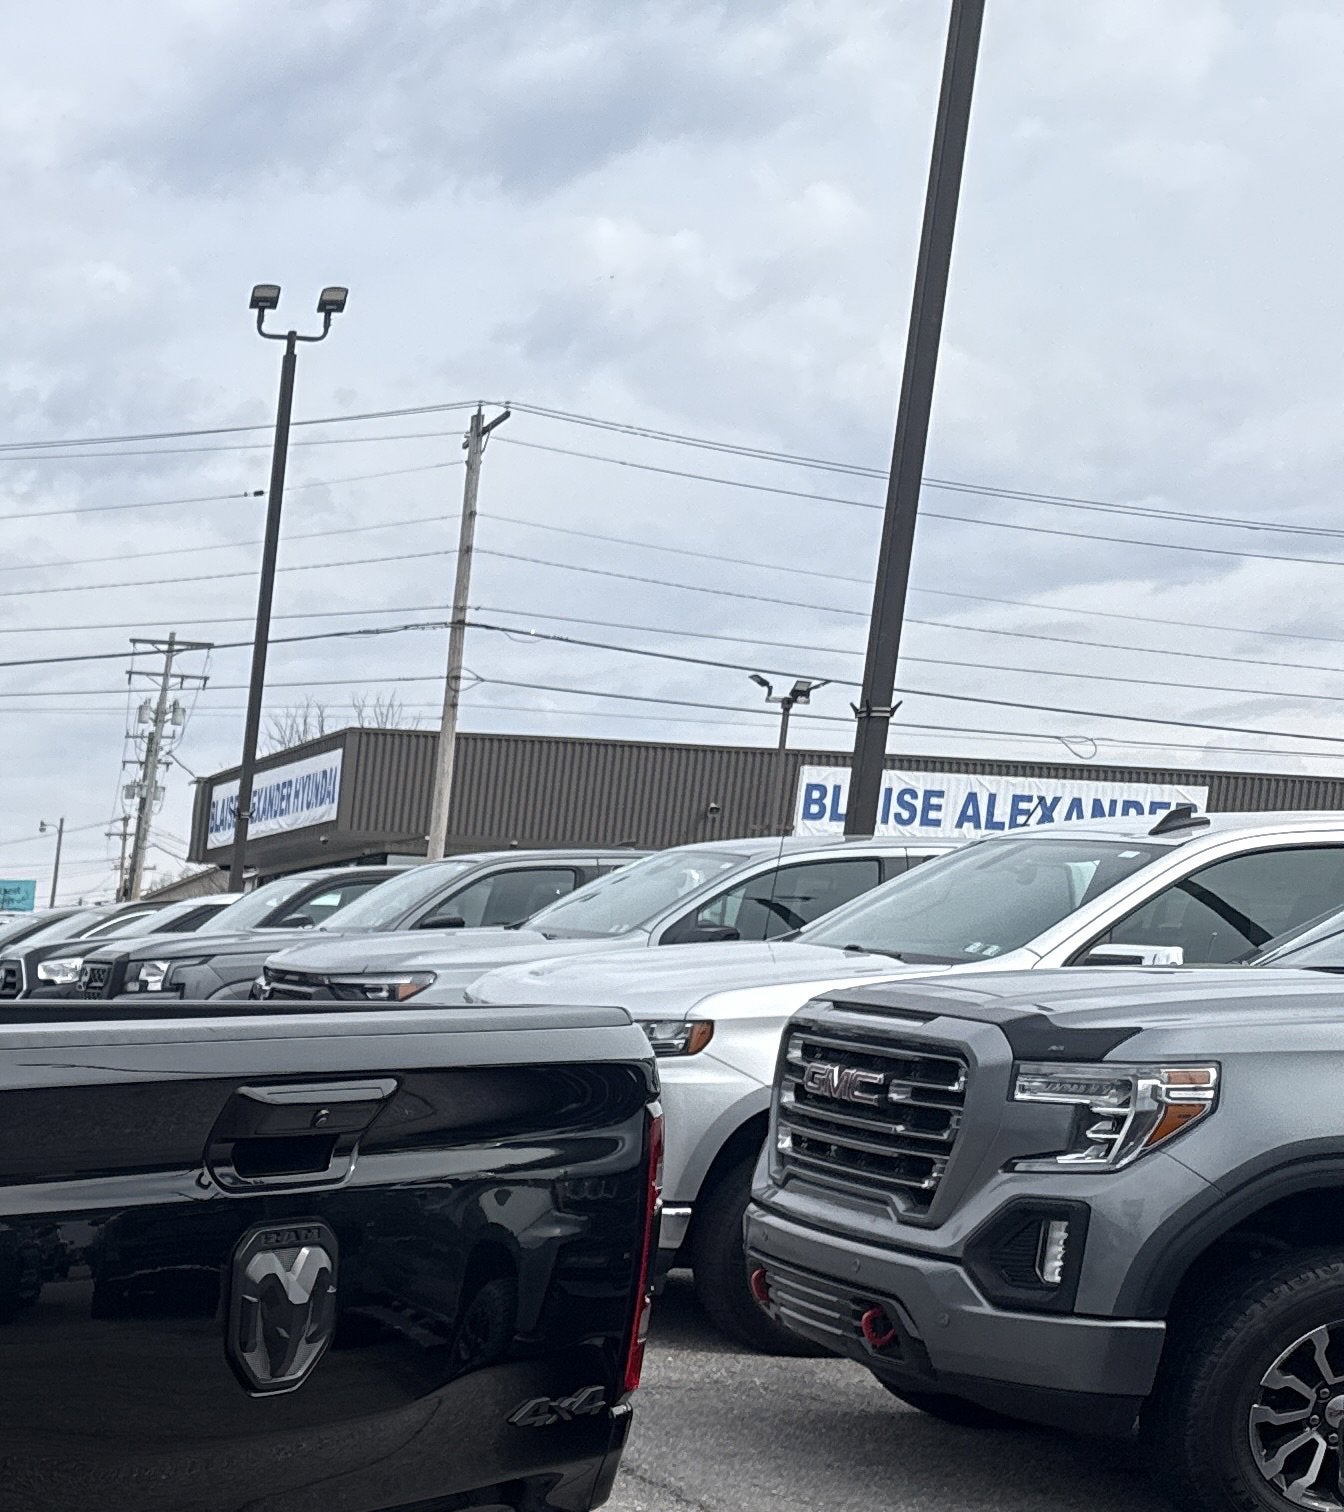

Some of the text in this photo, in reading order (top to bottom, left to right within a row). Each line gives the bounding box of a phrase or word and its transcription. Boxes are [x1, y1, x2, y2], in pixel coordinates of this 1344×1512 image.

[249, 779, 293, 824] EXANDER
[292, 766, 338, 814] HYUNDAI
[802, 783, 946, 828] BLISE
[804, 1062, 884, 1106] GMC
[261, 1227, 321, 1245] RAM
